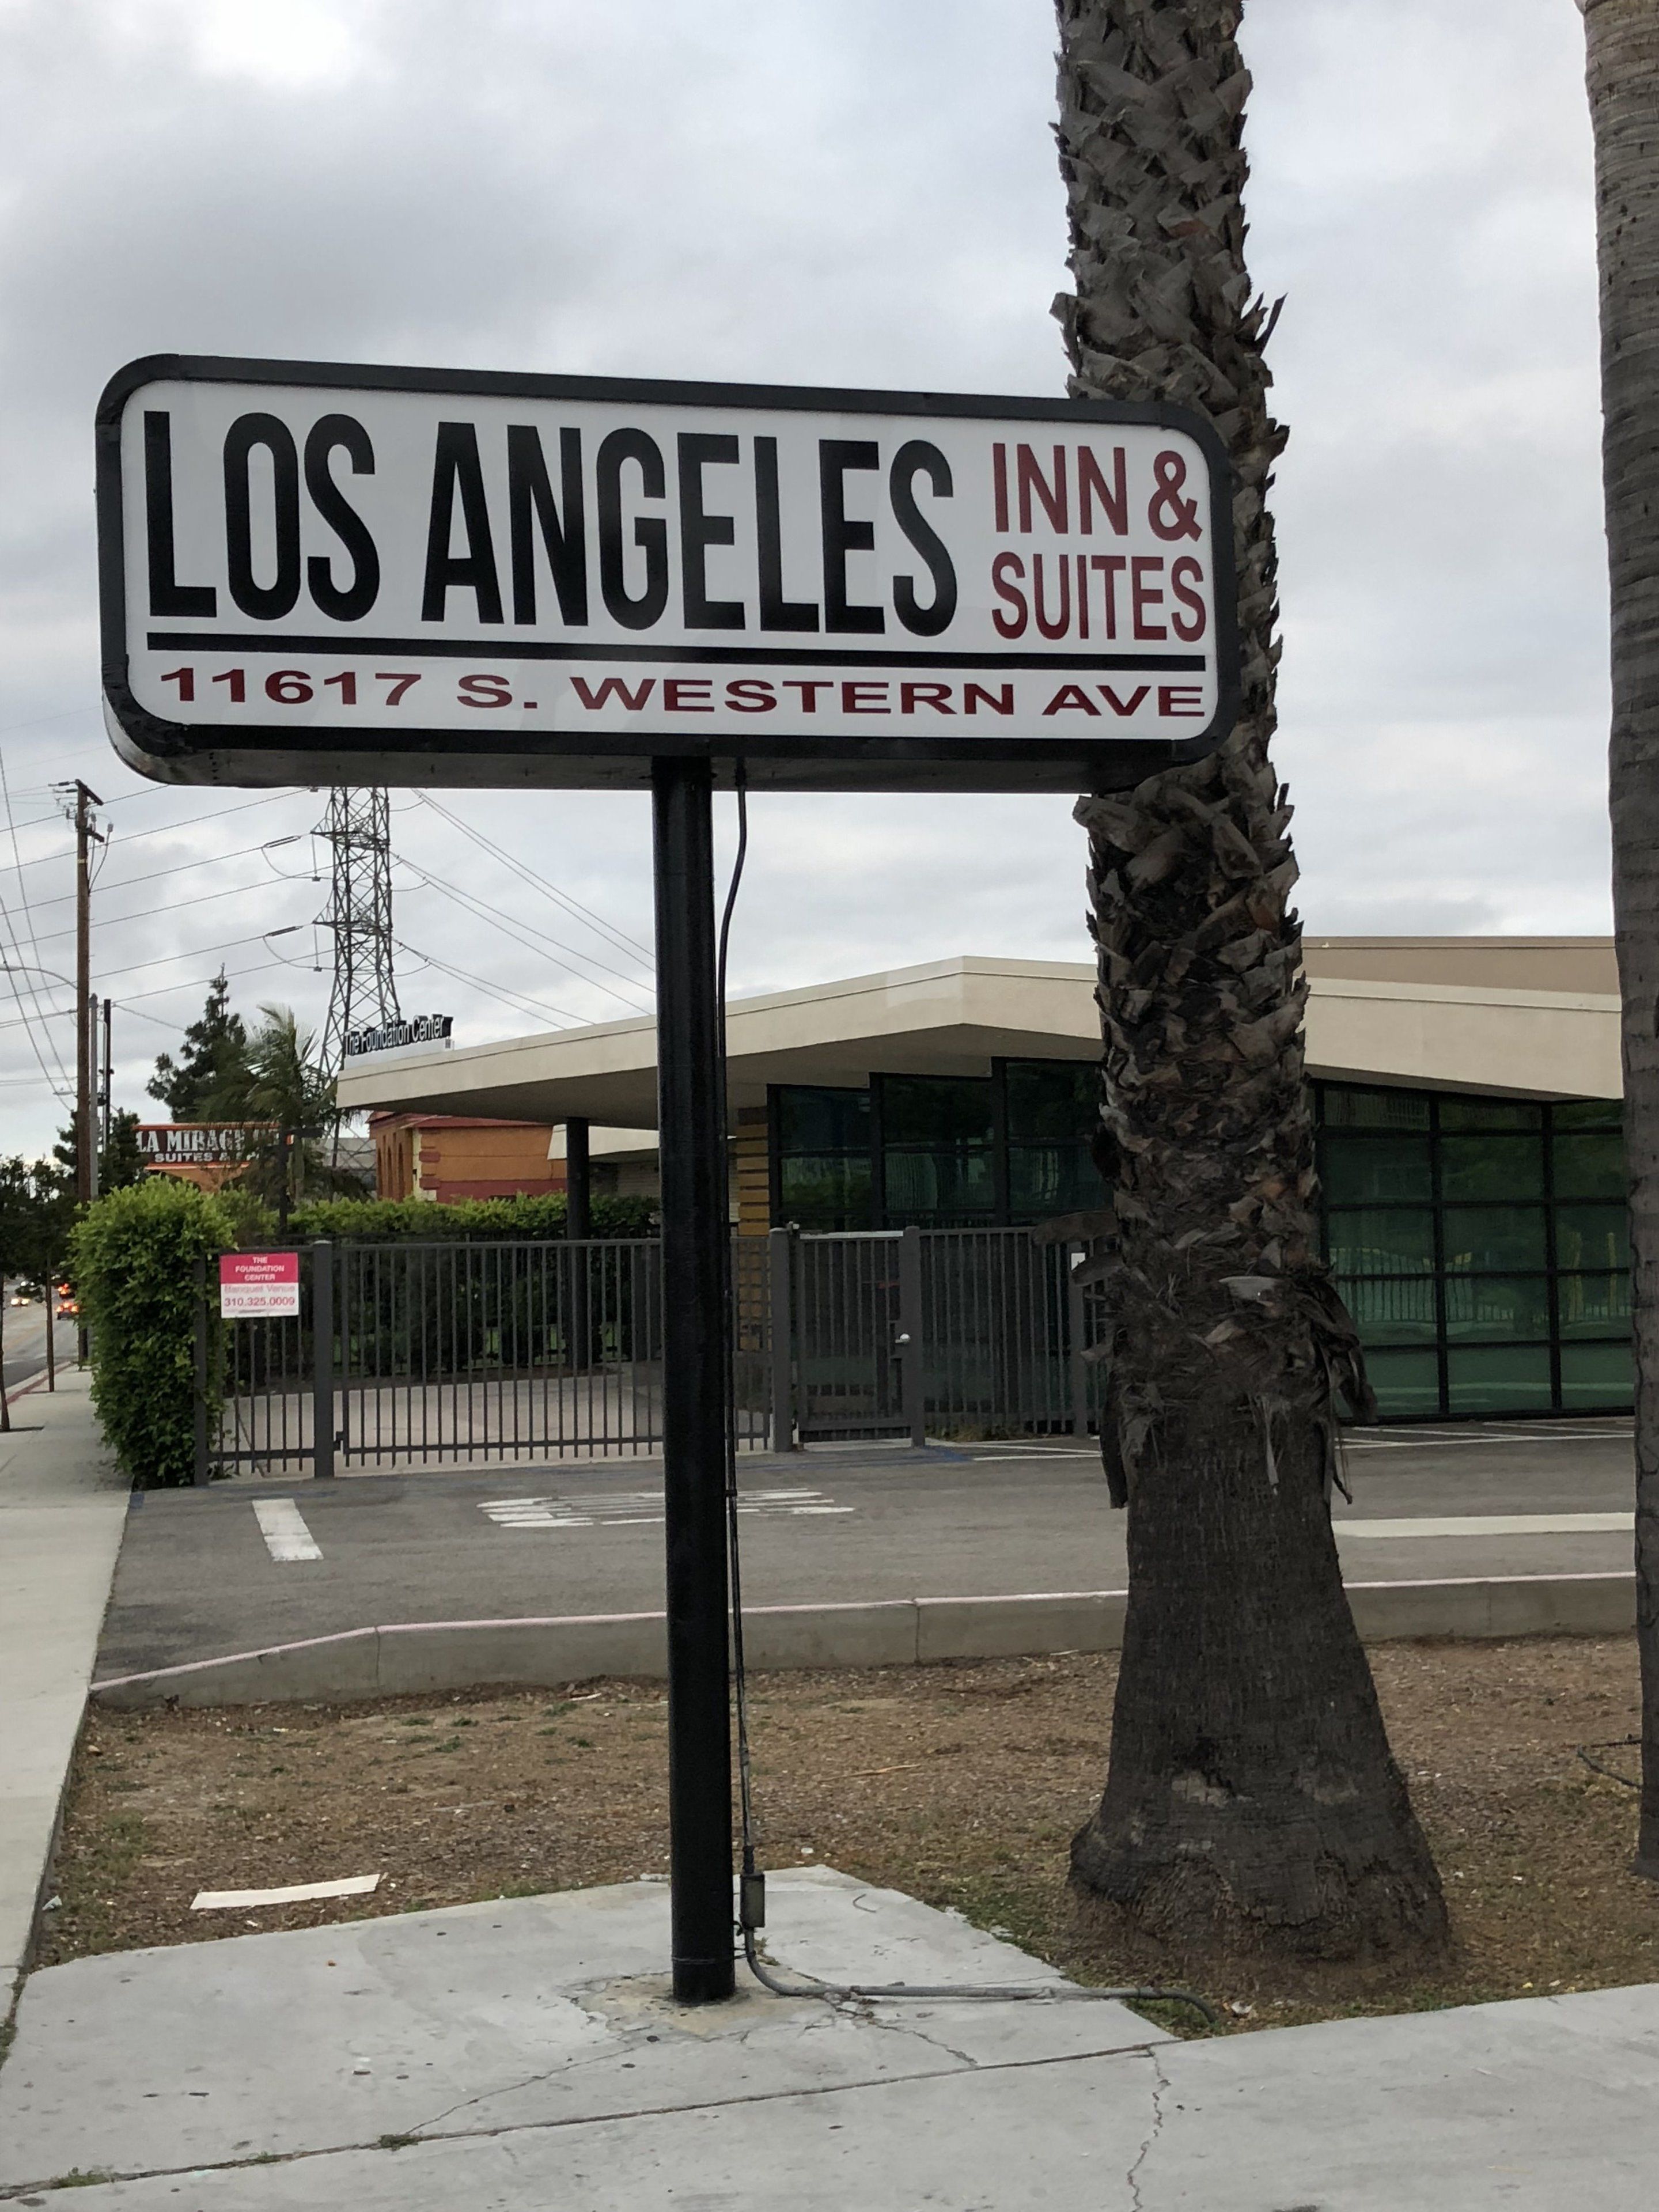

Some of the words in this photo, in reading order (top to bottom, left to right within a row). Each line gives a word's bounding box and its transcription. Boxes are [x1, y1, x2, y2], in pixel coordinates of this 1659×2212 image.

[992, 442, 1128, 536] INN
[1147, 450, 1203, 542] &
[144, 411, 380, 621] LOS
[421, 422, 957, 637] ANGELES
[991, 551, 1206, 642] SUITES
[160, 667, 422, 706] 11617
[457, 673, 538, 709] S.
[569, 676, 1014, 715] WESTERN
[1041, 684, 1205, 717] AVE
[346, 1031, 360, 1055] The
[361, 1019, 410, 1052] Foundation
[411, 1015, 446, 1042] Center
[135, 1130, 160, 1152] LA
[154, 1153, 213, 1162] SUITES
[224, 1297, 295, 1306] 310.325.0009
